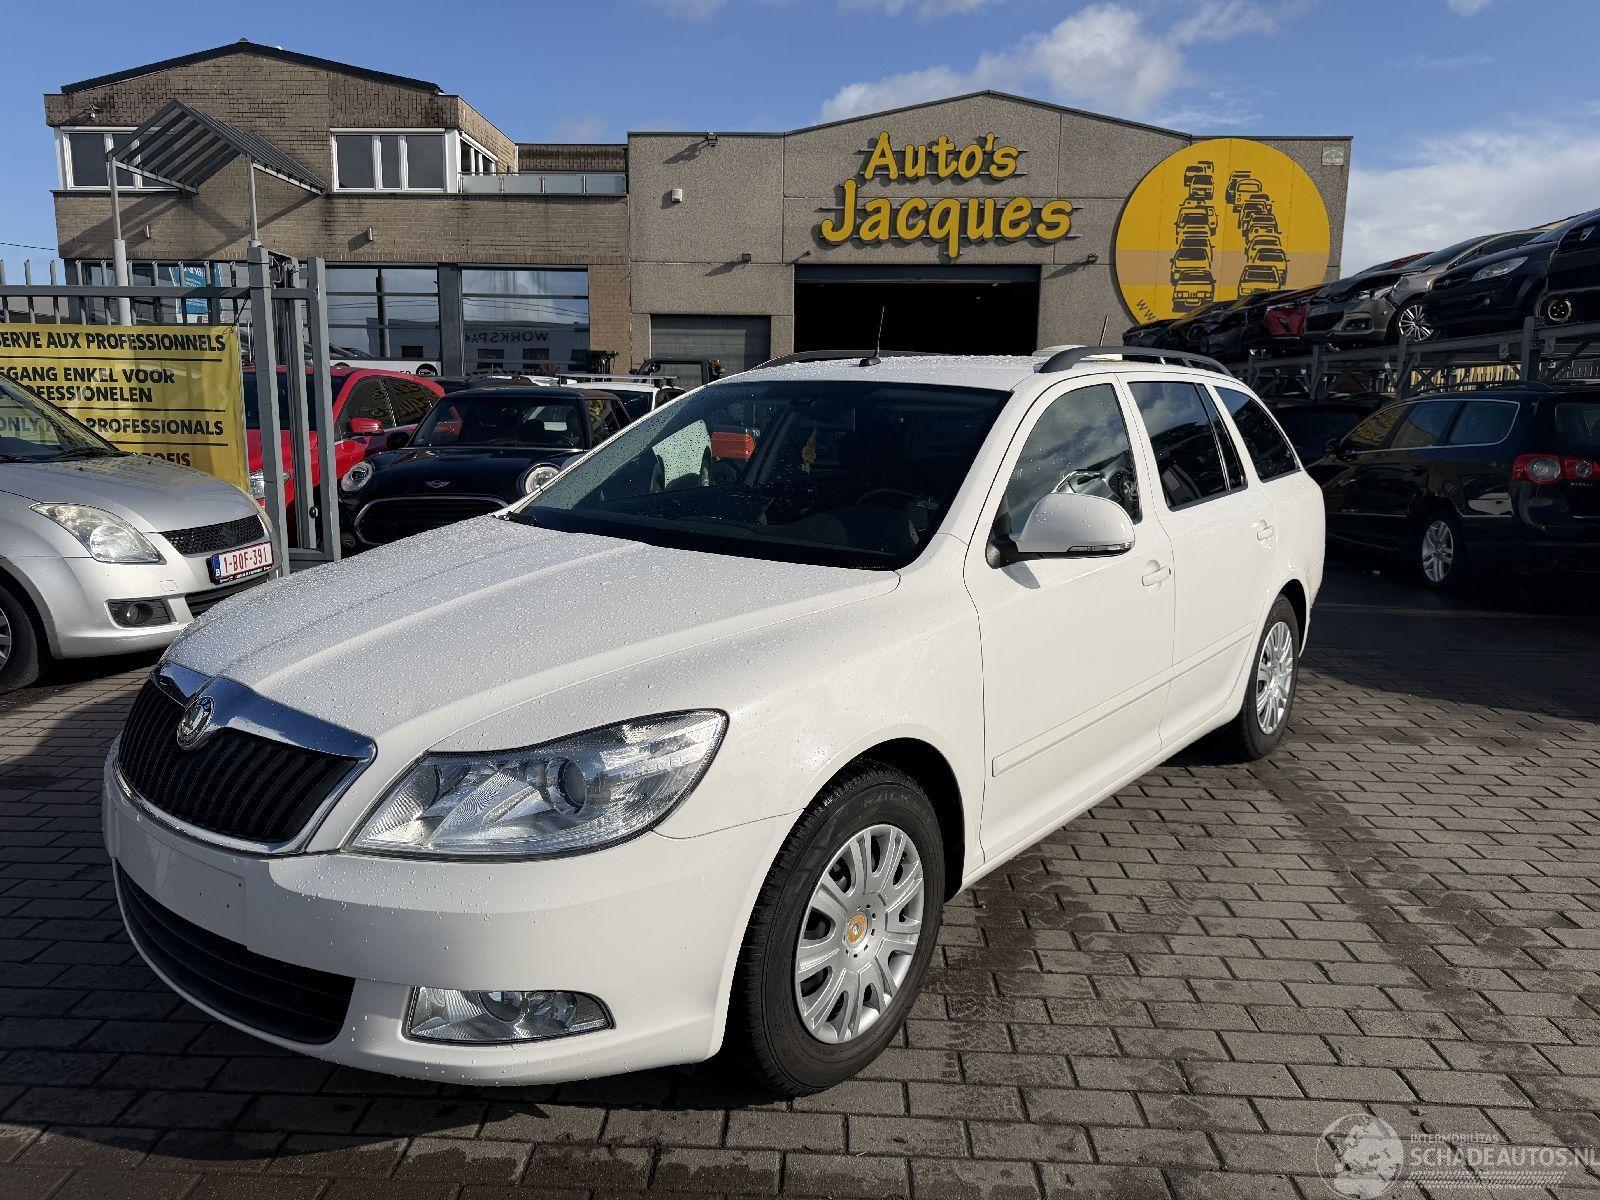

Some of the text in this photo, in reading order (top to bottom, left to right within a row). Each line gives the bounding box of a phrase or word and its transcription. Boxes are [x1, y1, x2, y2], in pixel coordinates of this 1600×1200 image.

[864, 131, 1019, 181] Auto's
[821, 179, 1073, 258] Jacques
[0, 331, 225, 351] ERVE AUX PROFESSIONNELS
[64, 367, 118, 383] ENKEL
[122, 368, 175, 383] VOOR
[25, 385, 152, 402] FESSIONELEN
[86, 418, 223, 435] PROFESSIONALS
